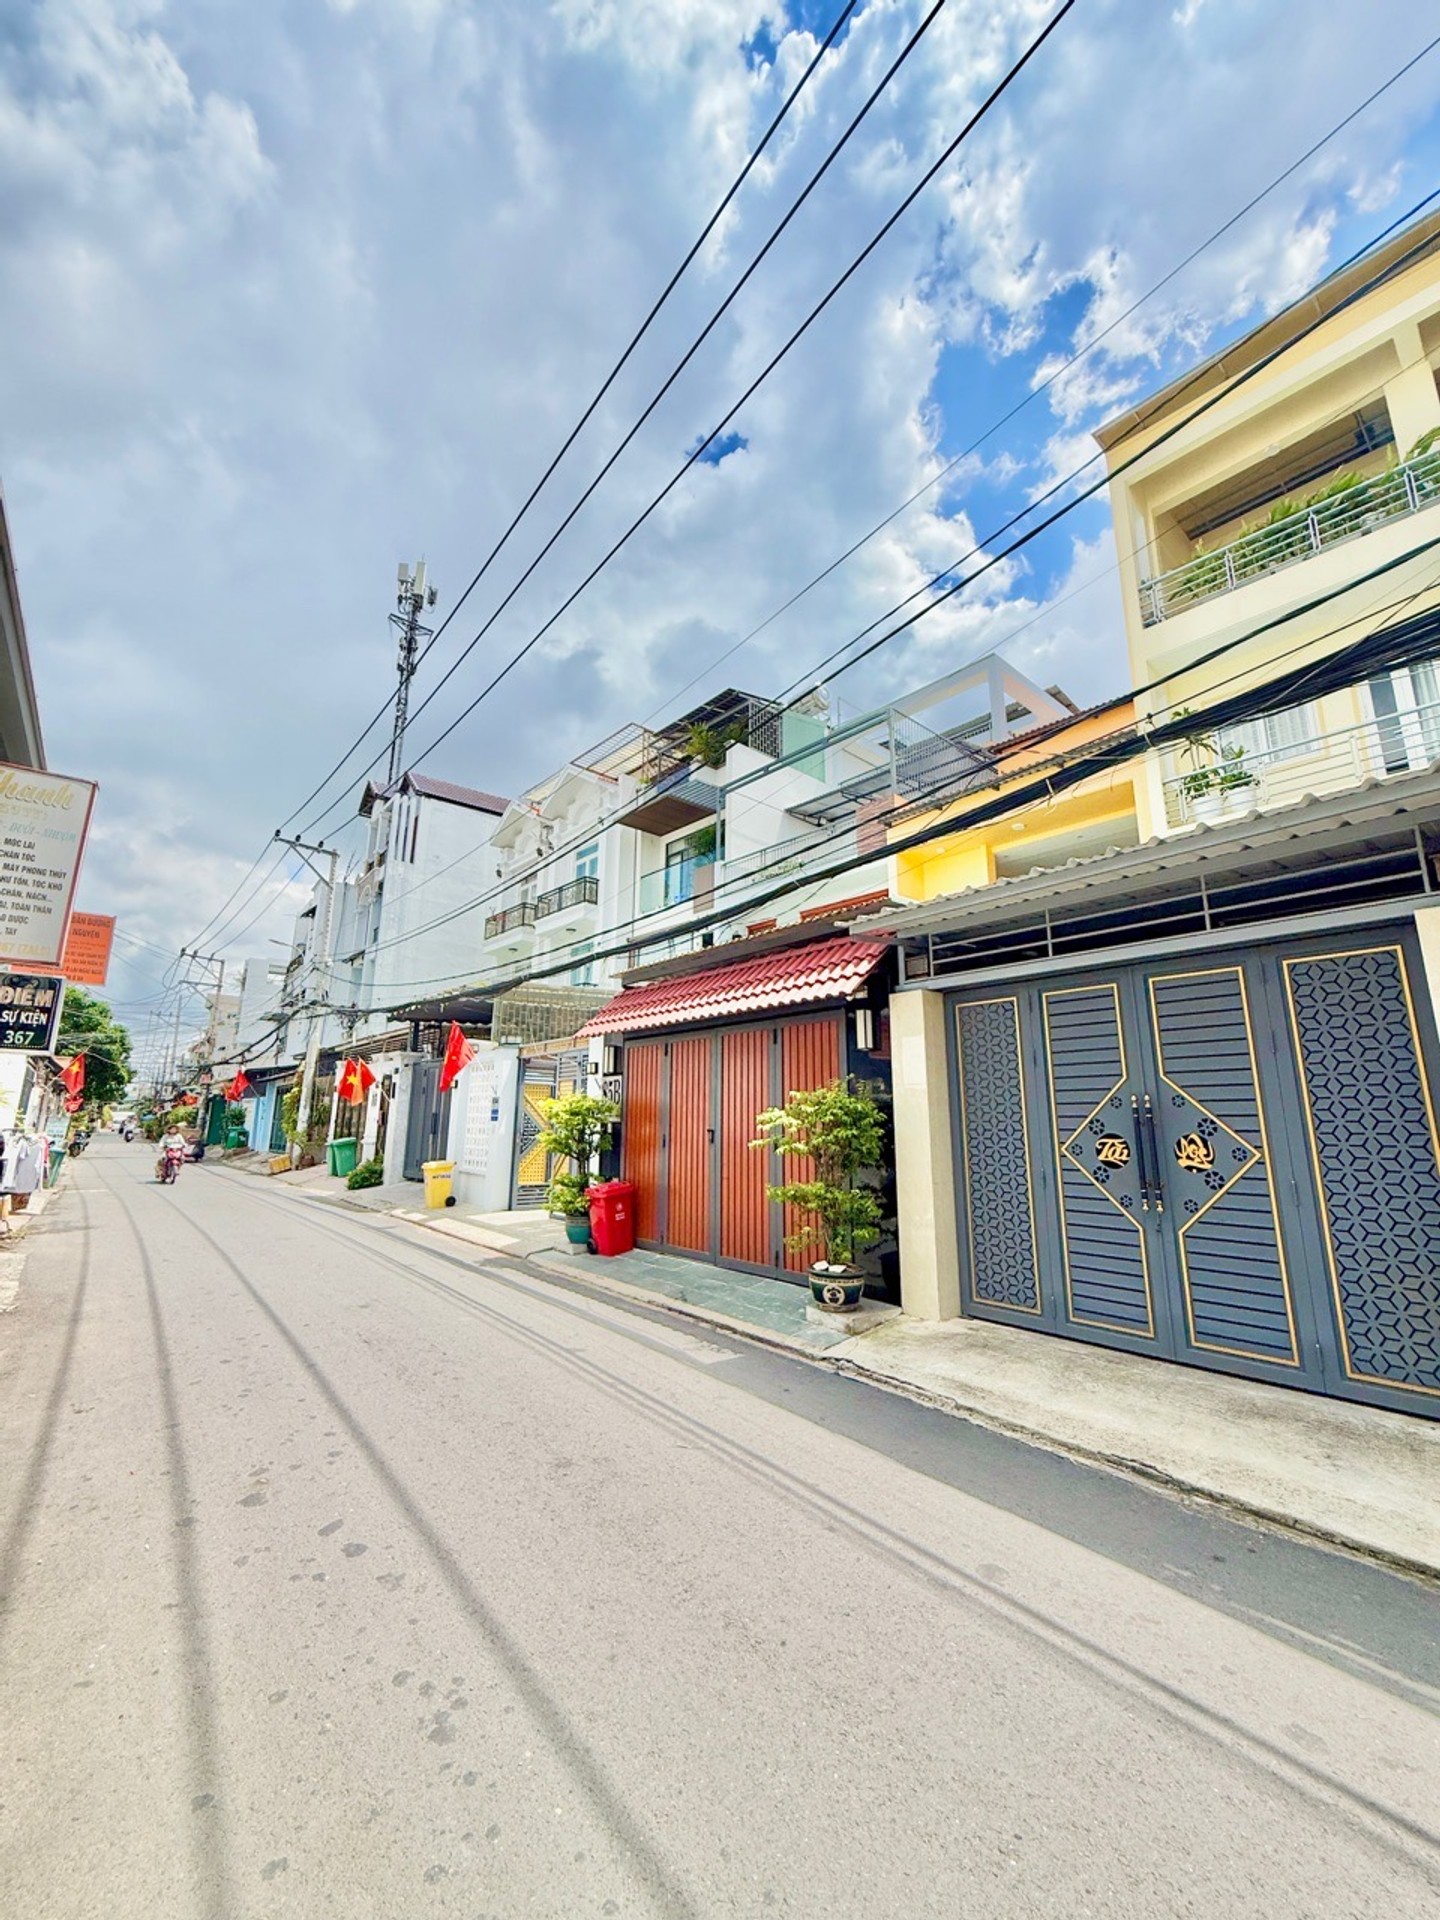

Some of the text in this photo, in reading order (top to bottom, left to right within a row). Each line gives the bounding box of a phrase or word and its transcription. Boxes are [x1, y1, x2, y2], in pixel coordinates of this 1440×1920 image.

[0, 980, 54, 1007] ĐIỂM
[20, 1009, 48, 1027] KIỆN
[3, 1030, 35, 1045] 367
